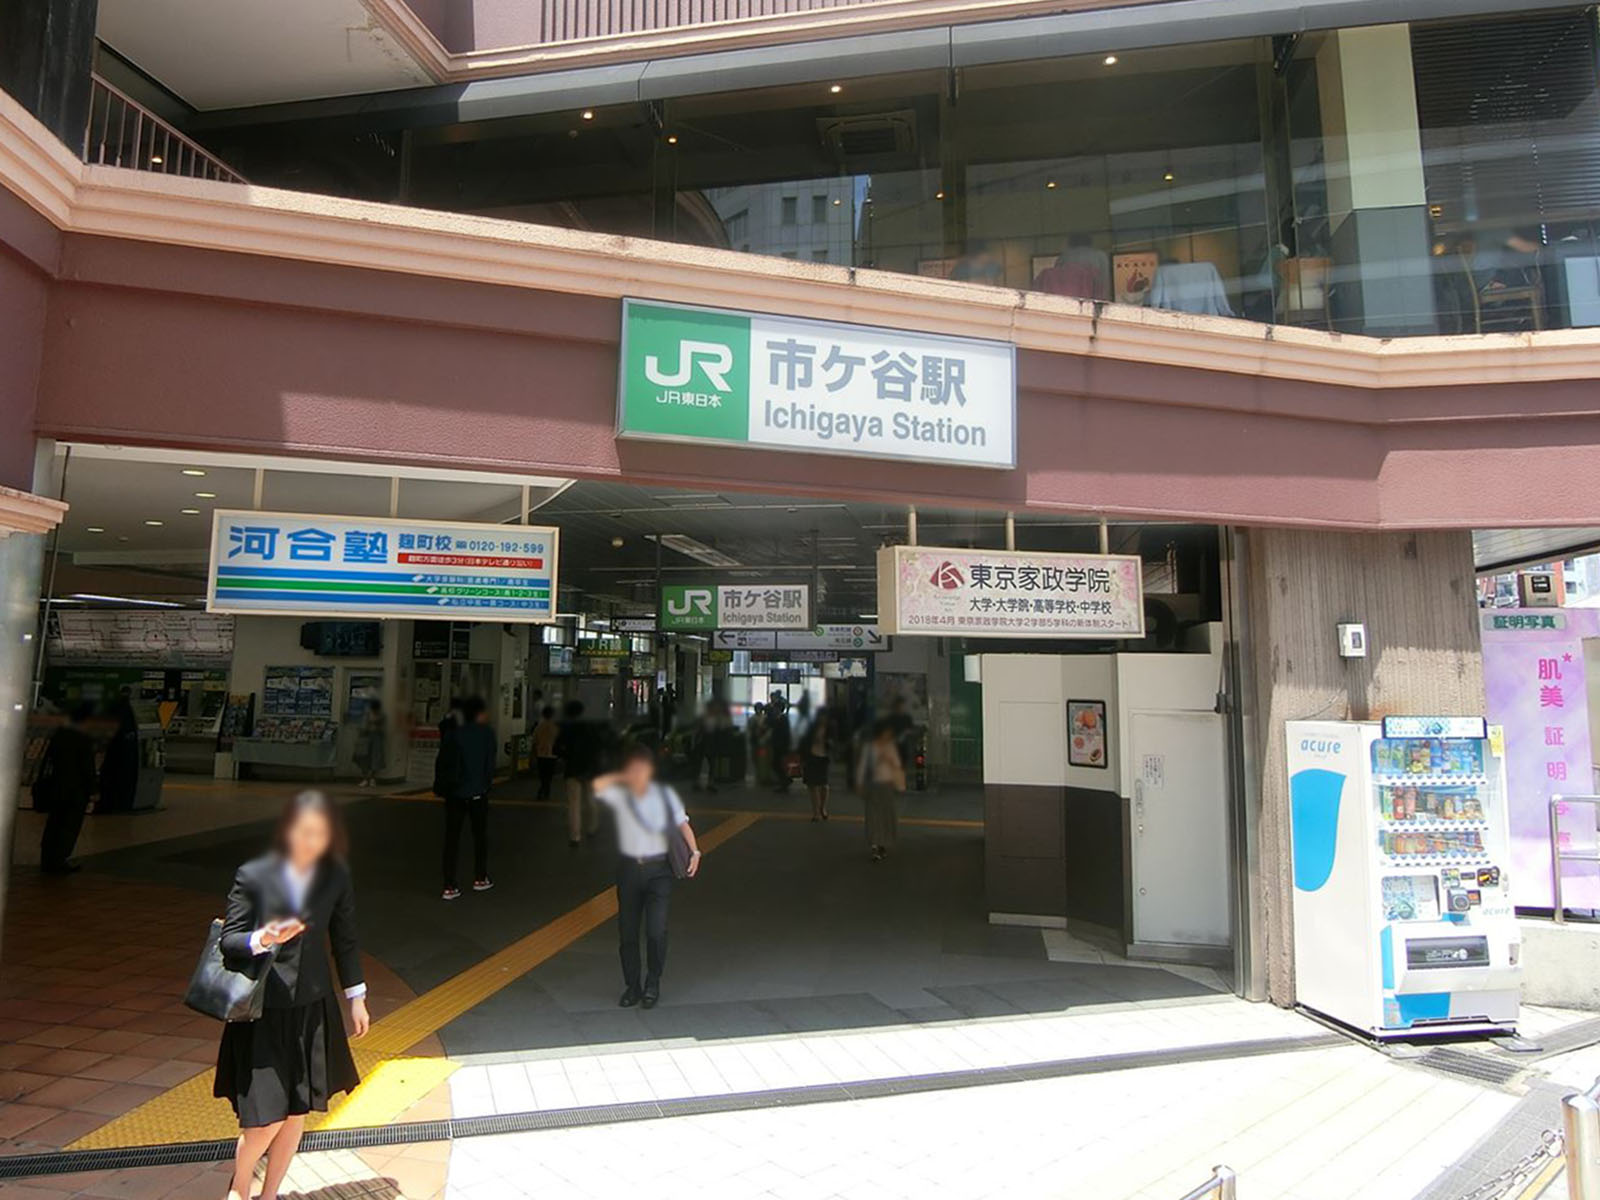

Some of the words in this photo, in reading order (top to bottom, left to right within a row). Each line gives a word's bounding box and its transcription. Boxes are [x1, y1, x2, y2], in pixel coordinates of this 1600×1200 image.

[645, 339, 733, 393] JR
[766, 338, 966, 407] 市ケ谷駅
[656, 390, 722, 409] JR東日本
[764, 399, 883, 442] Ichigaya
[892, 412, 986, 446] Station
[228, 526, 388, 563] 河合塾
[969, 564, 1111, 593] 東京家政学院
[668, 589, 712, 616] JR
[723, 590, 801, 609] 市ケ谷駅
[723, 612, 763, 626] Ichigaya
[766, 612, 801, 624] Station
[1493, 614, 1556, 630] 証明写真
[1301, 737, 1341, 754] acure
